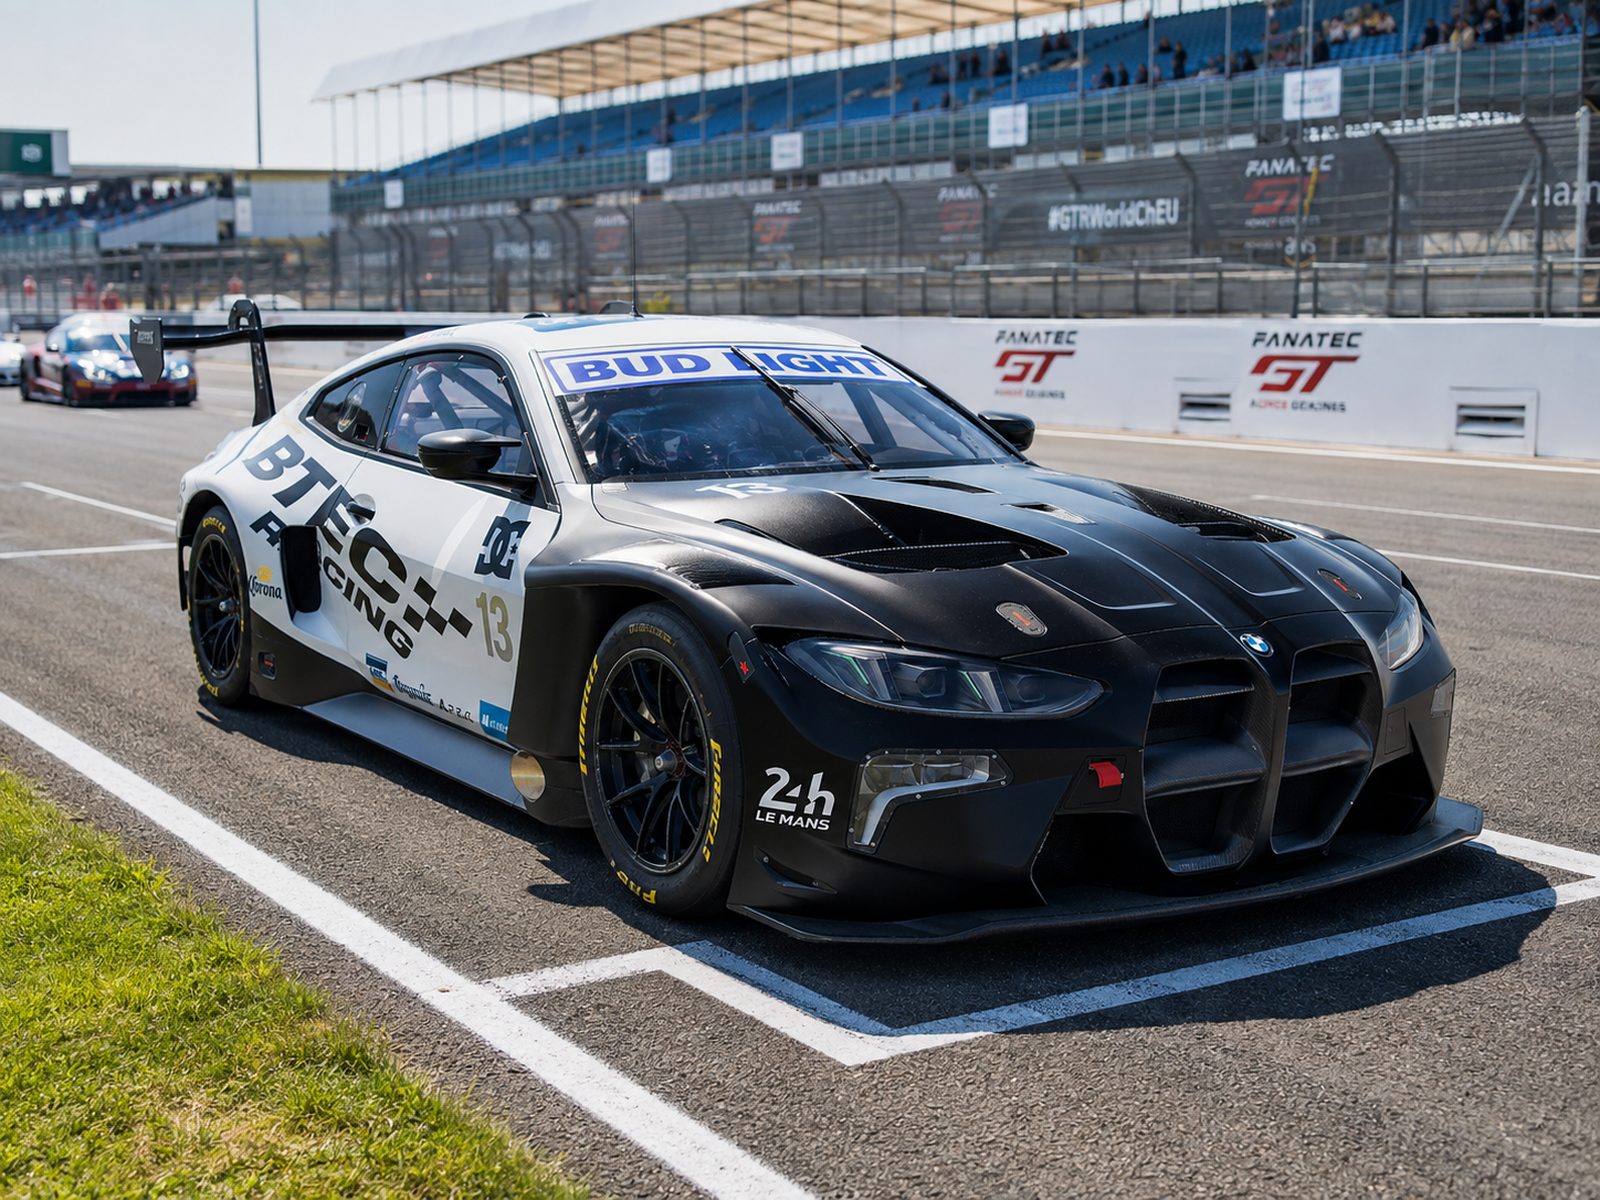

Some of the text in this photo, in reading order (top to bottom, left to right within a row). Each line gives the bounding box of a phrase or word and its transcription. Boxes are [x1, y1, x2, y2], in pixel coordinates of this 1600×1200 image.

[995, 330, 1077, 344] FANATEC
[1252, 331, 1362, 347] FANATEC
[566, 352, 887, 384] BUD LIGHT
[695, 482, 788, 499] 13
[245, 435, 408, 604] BTEC
[248, 575, 283, 600] Corona
[249, 510, 414, 659] RCING
[475, 591, 514, 663] 13
[755, 809, 830, 831] LE MANS
